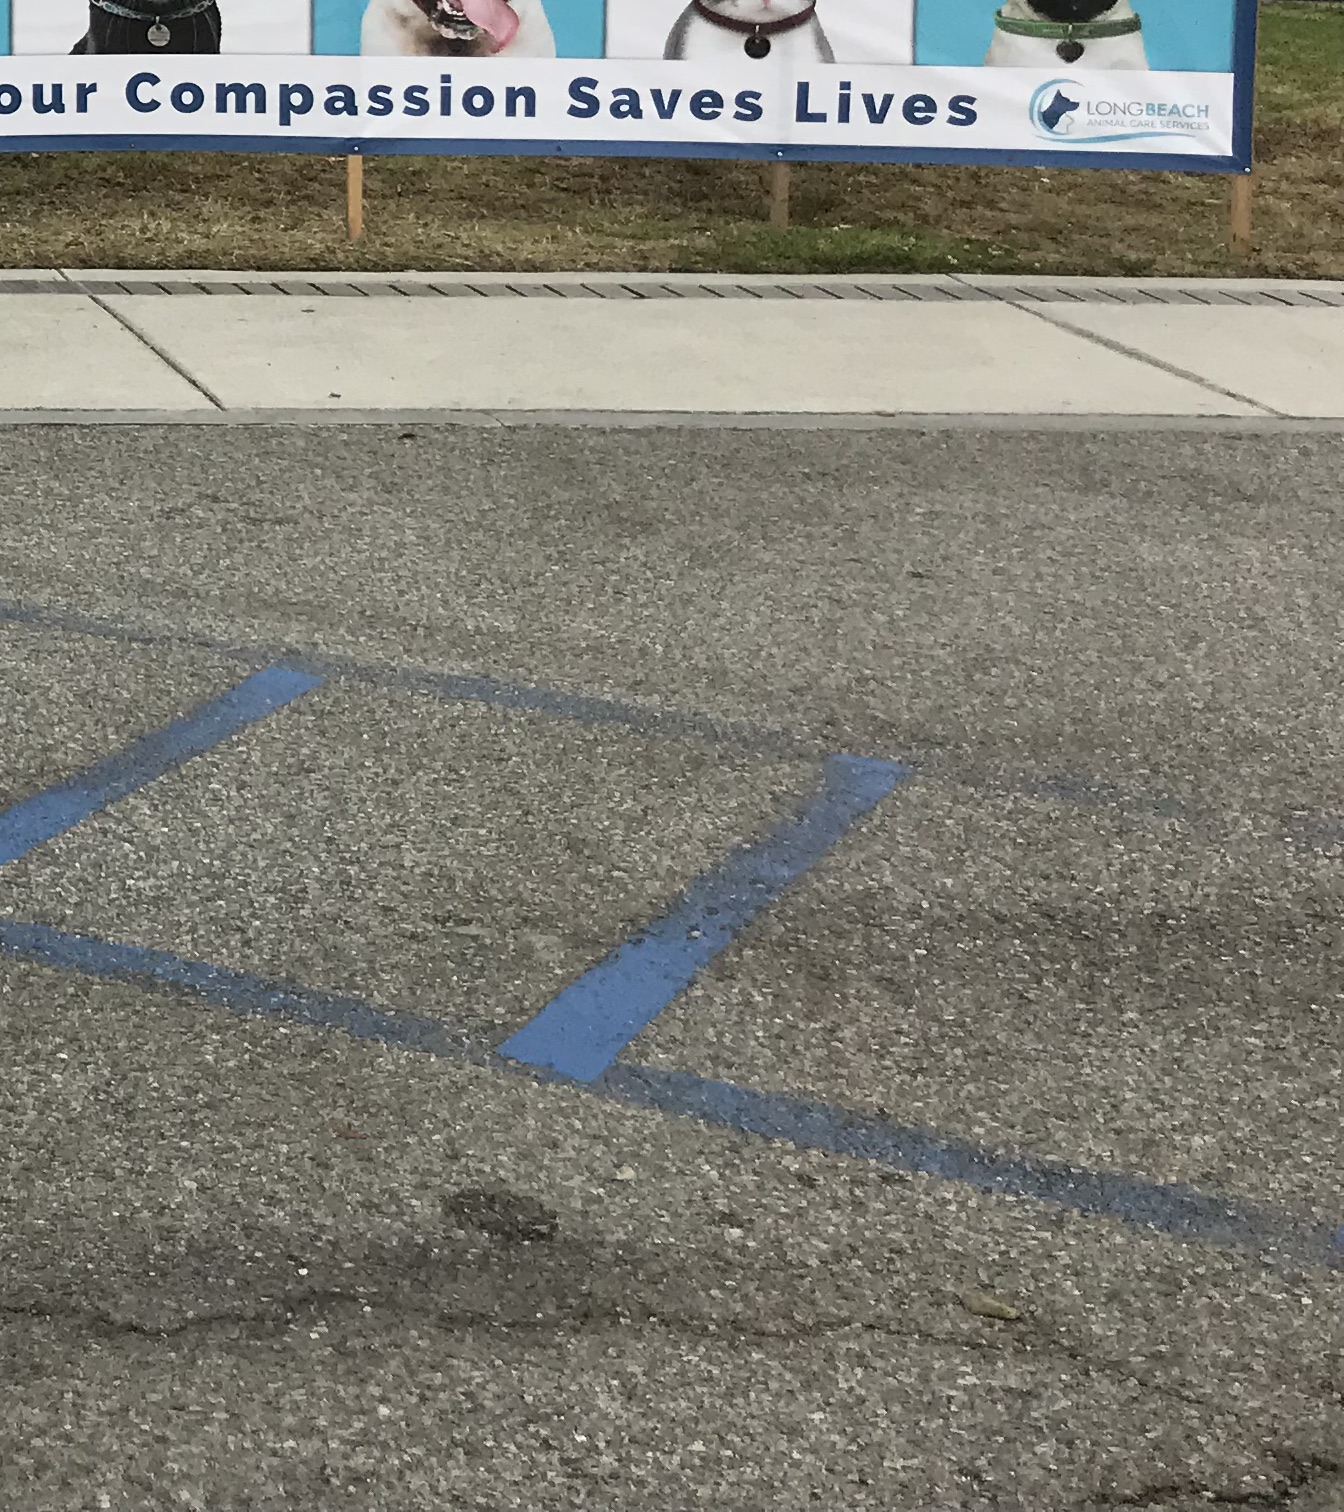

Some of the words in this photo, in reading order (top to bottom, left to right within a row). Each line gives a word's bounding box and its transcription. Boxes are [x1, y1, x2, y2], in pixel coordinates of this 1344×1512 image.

[124, 71, 536, 126] Compassion
[566, 76, 764, 122] Saves
[795, 80, 979, 127] Lives
[1086, 118, 1127, 129] ANIMAL
[1129, 119, 1156, 129] CARE
[1159, 120, 1211, 131] SERVICES
